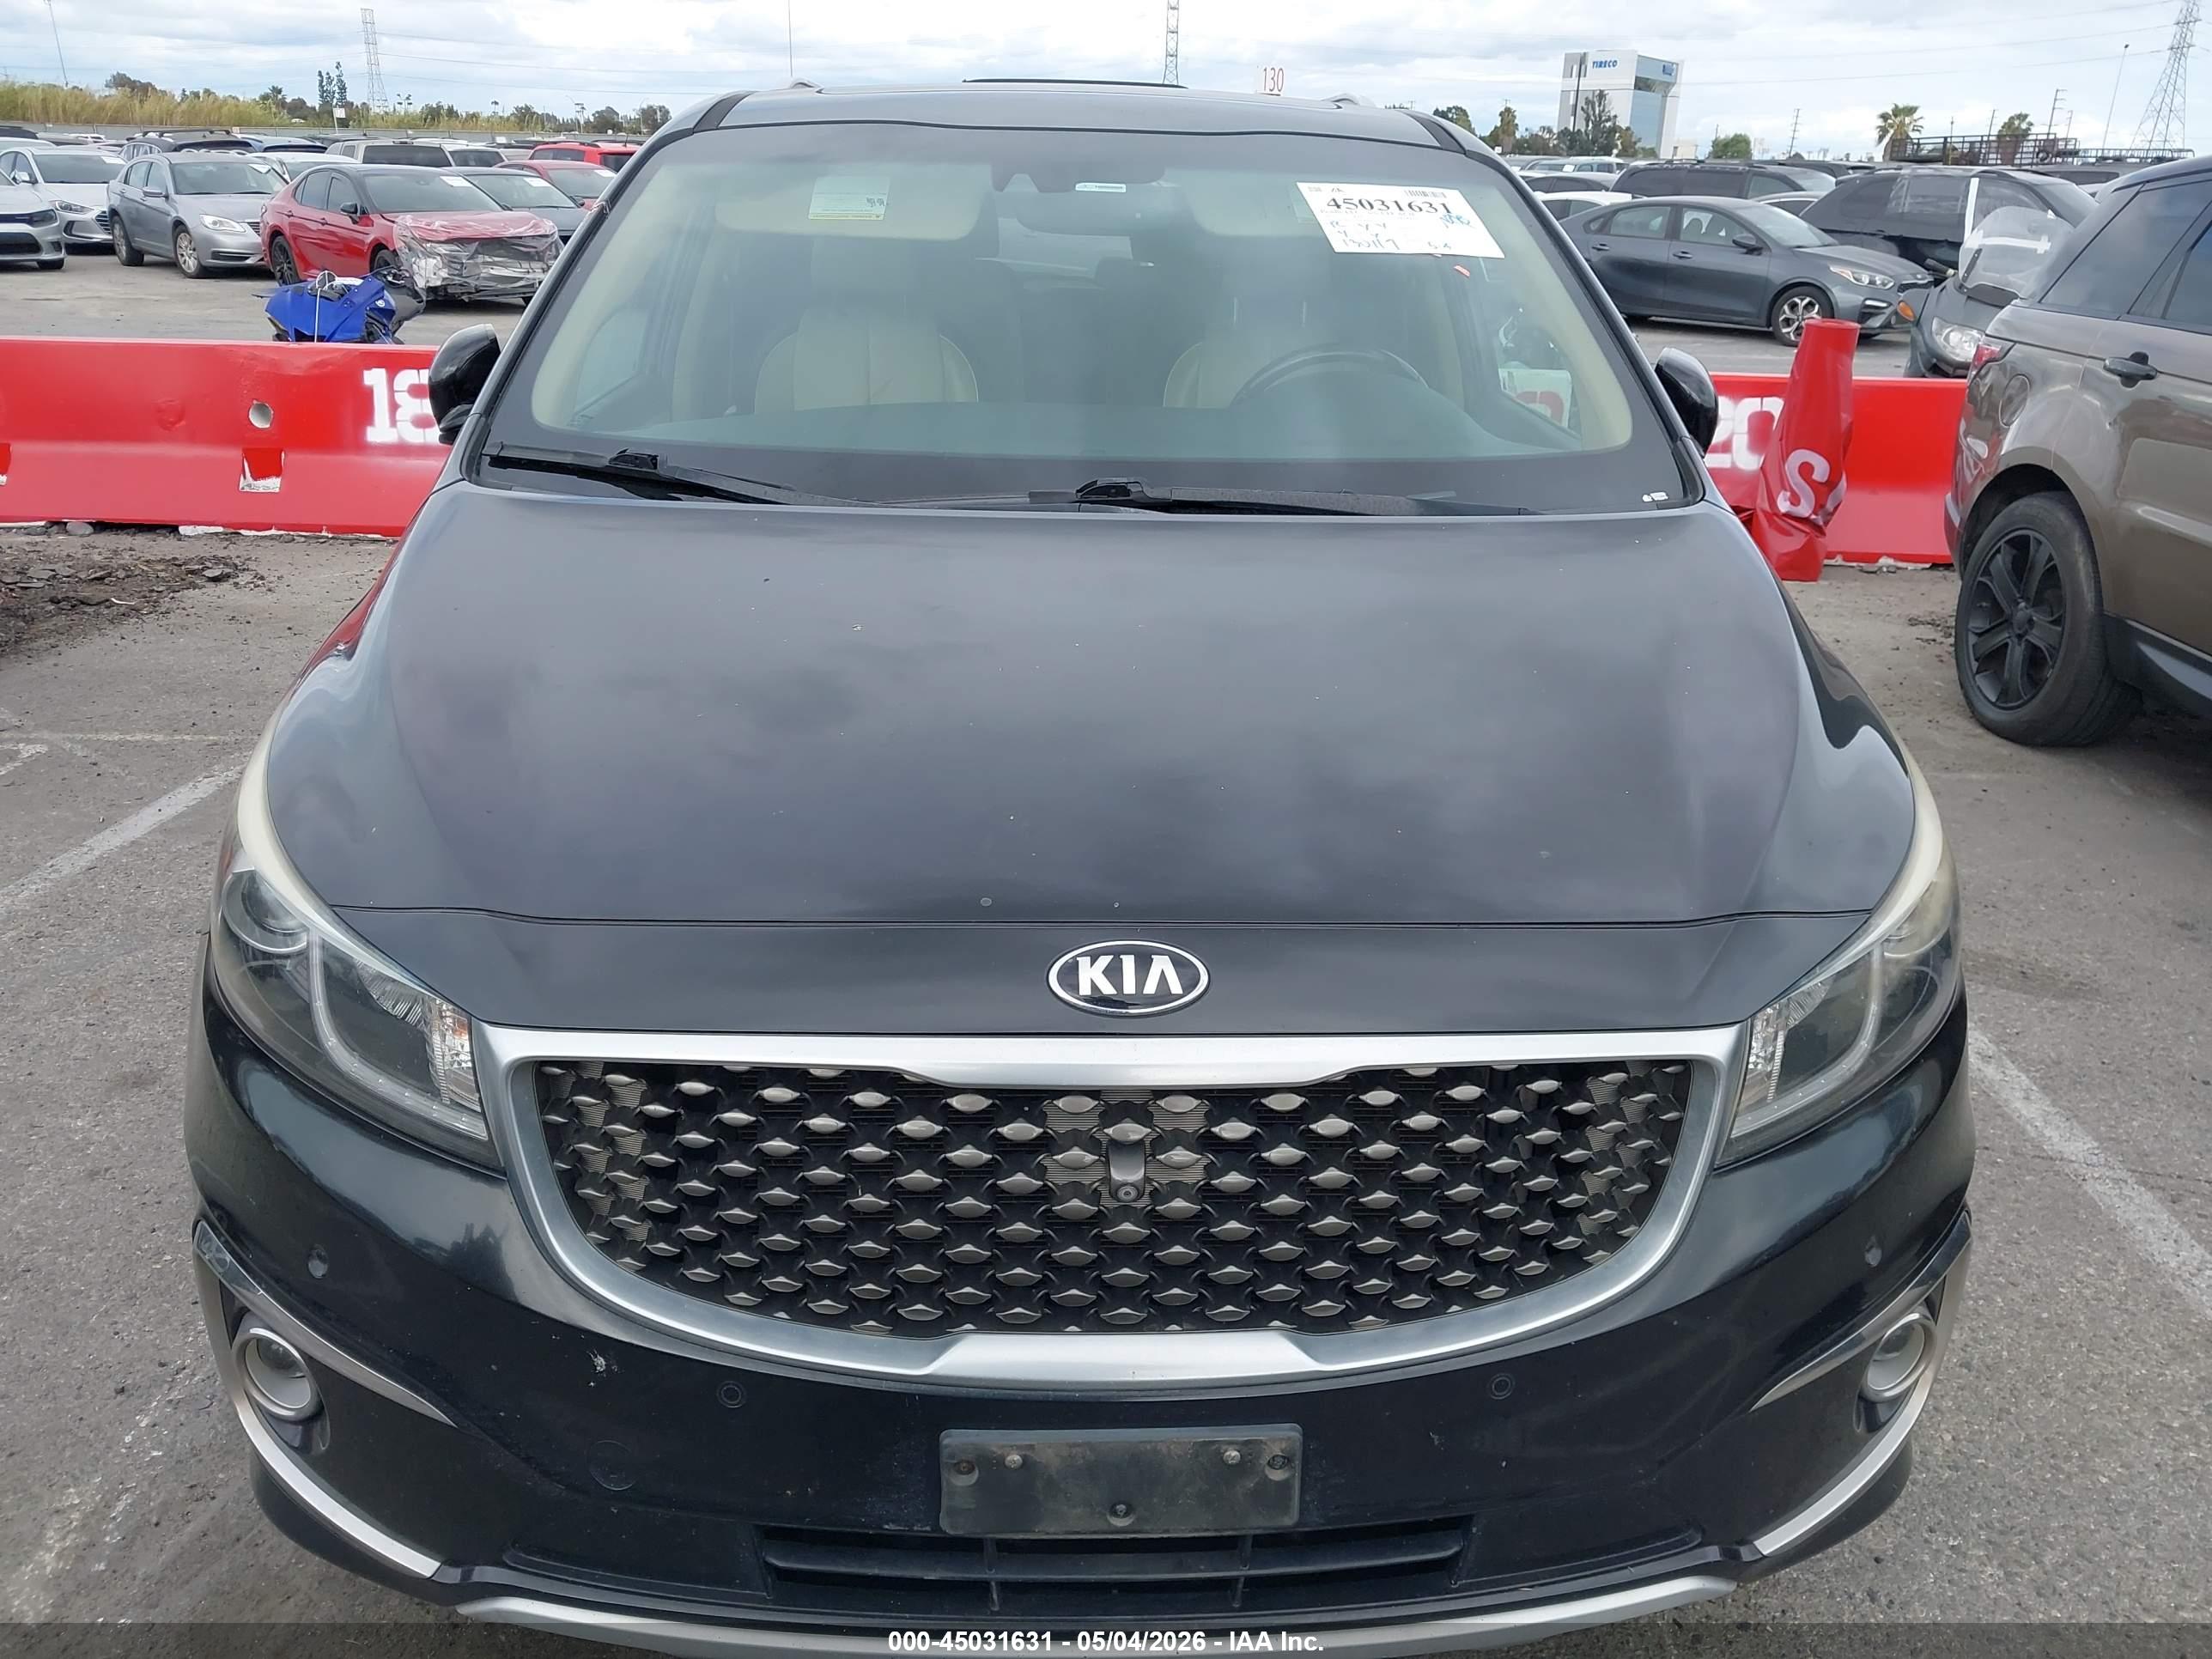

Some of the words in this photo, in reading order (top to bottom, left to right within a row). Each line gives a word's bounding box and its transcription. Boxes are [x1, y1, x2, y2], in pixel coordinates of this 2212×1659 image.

[1592, 59, 1618, 69] TIRECO
[1263, 66, 1285, 92] 130
[1327, 197, 1453, 215] 45031631
[1076, 954, 1184, 996] KIA
